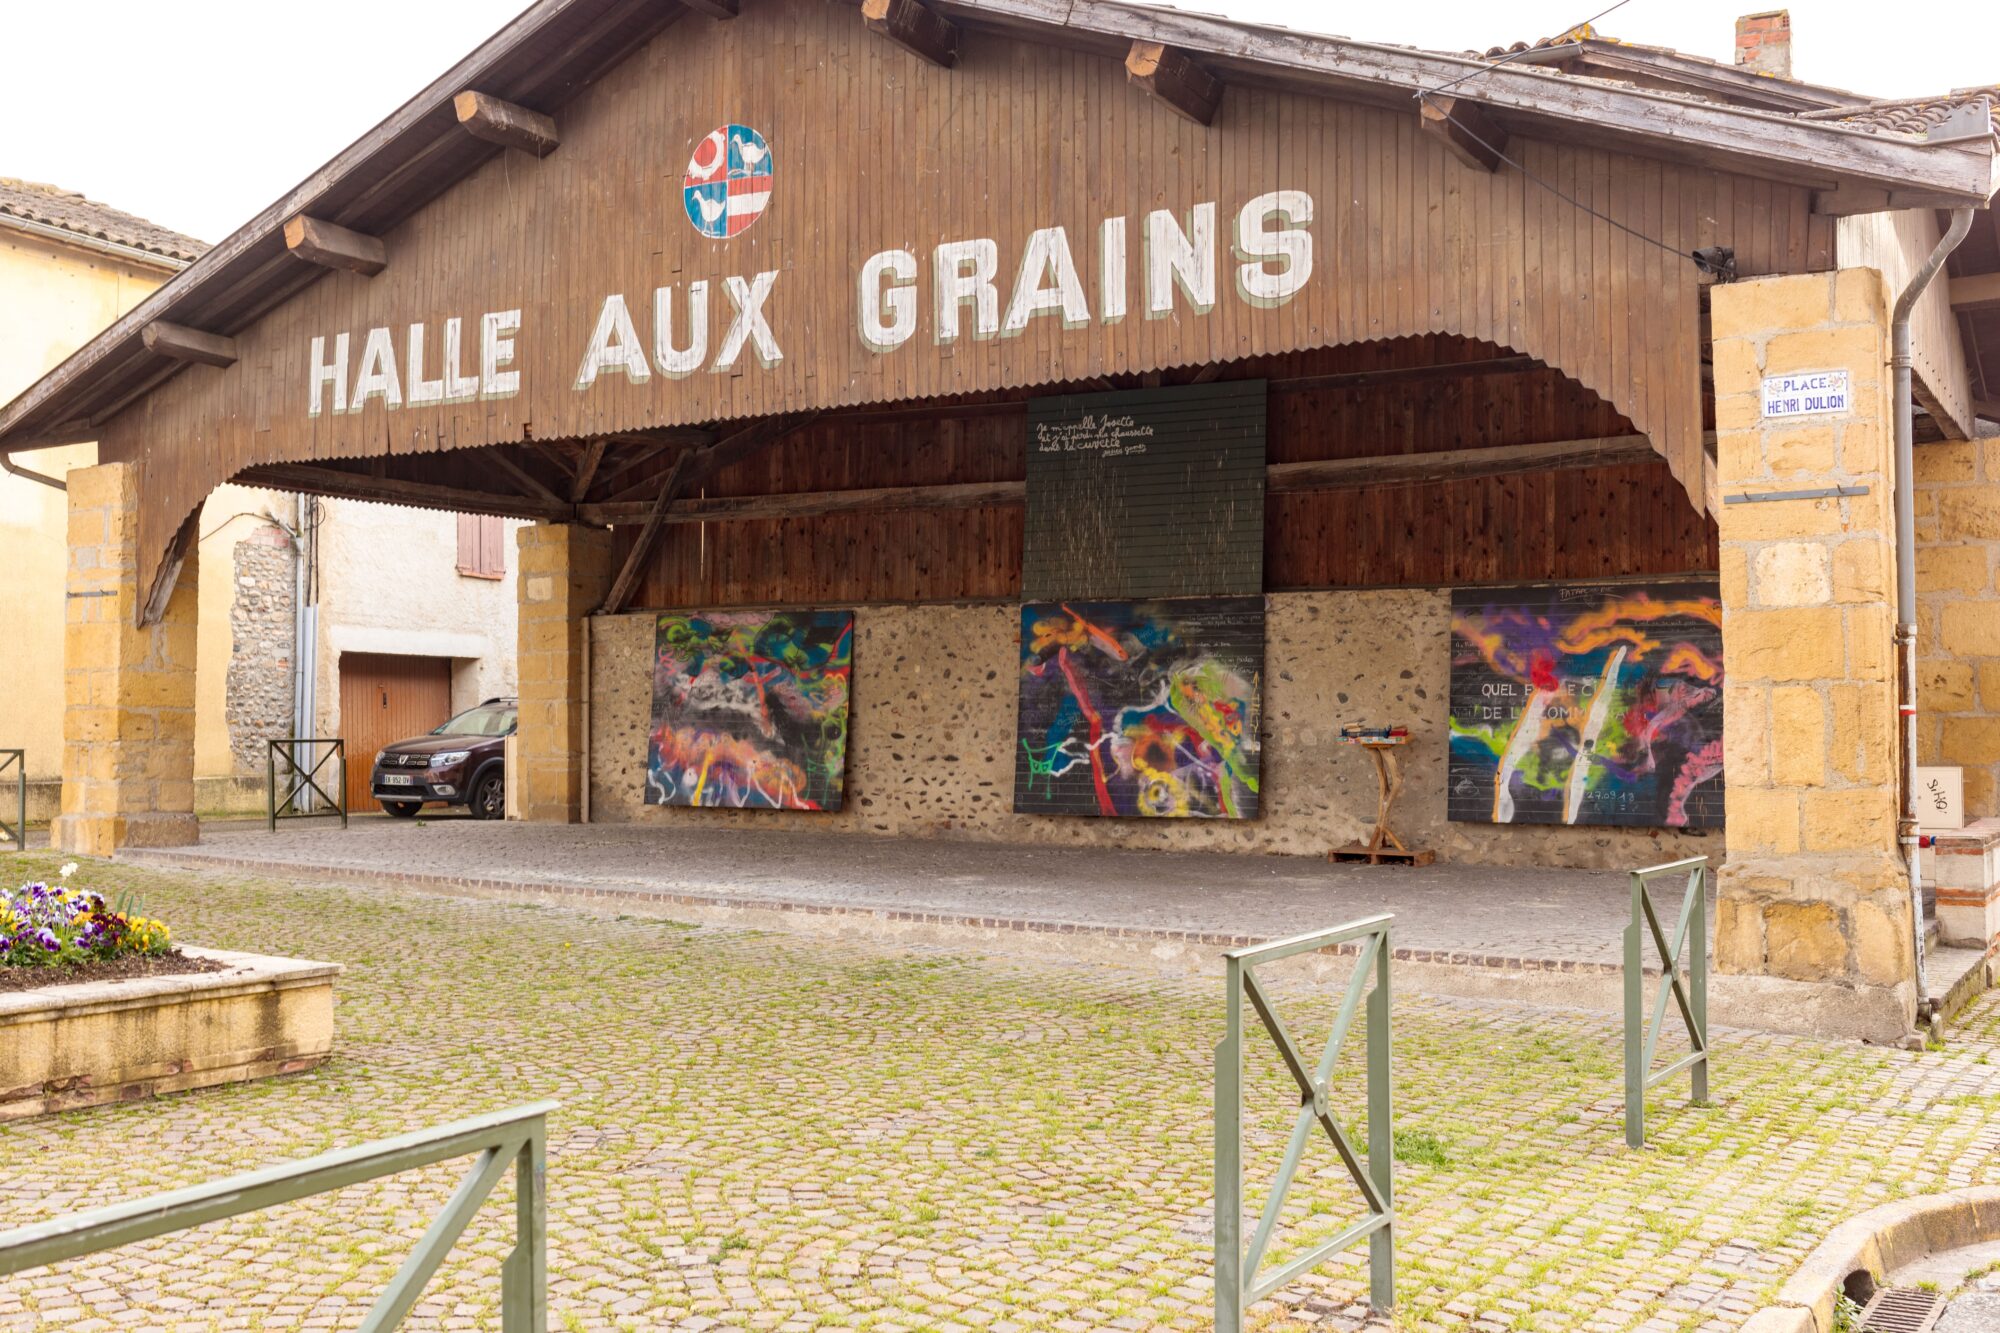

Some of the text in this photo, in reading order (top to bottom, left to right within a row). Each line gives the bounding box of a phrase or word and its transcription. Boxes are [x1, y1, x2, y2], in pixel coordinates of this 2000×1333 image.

[308, 189, 1314, 417] HALLE AUX GRAINS
[1783, 377, 1827, 392] PLACE
[1767, 394, 1844, 414] HENRI DULION
[1481, 683, 1517, 698] QUEL
[1483, 706, 1502, 720] DE
